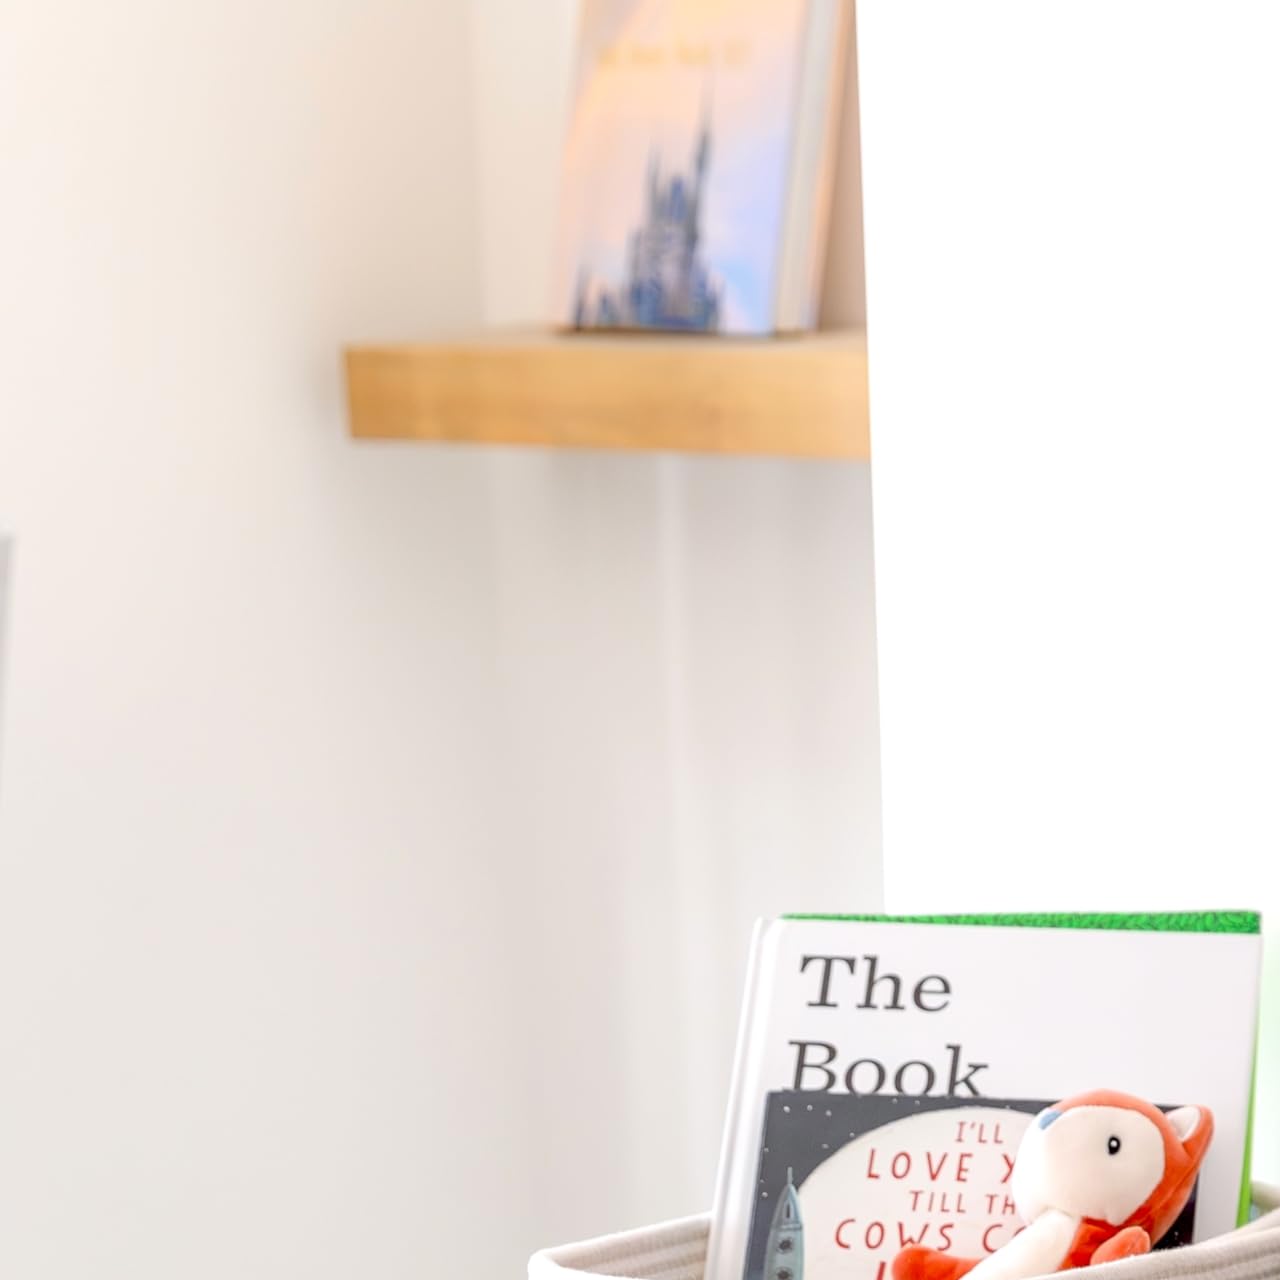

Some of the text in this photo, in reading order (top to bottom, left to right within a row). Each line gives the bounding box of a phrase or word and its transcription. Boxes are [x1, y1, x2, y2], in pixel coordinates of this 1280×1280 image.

[800, 954, 952, 1012] The
[787, 1040, 989, 1099] Book
[956, 1121, 1003, 1144] I'LL
[867, 1149, 973, 1182] LOVE
[909, 1190, 1016, 1215] TILL TH
[835, 1218, 954, 1251] COWS
